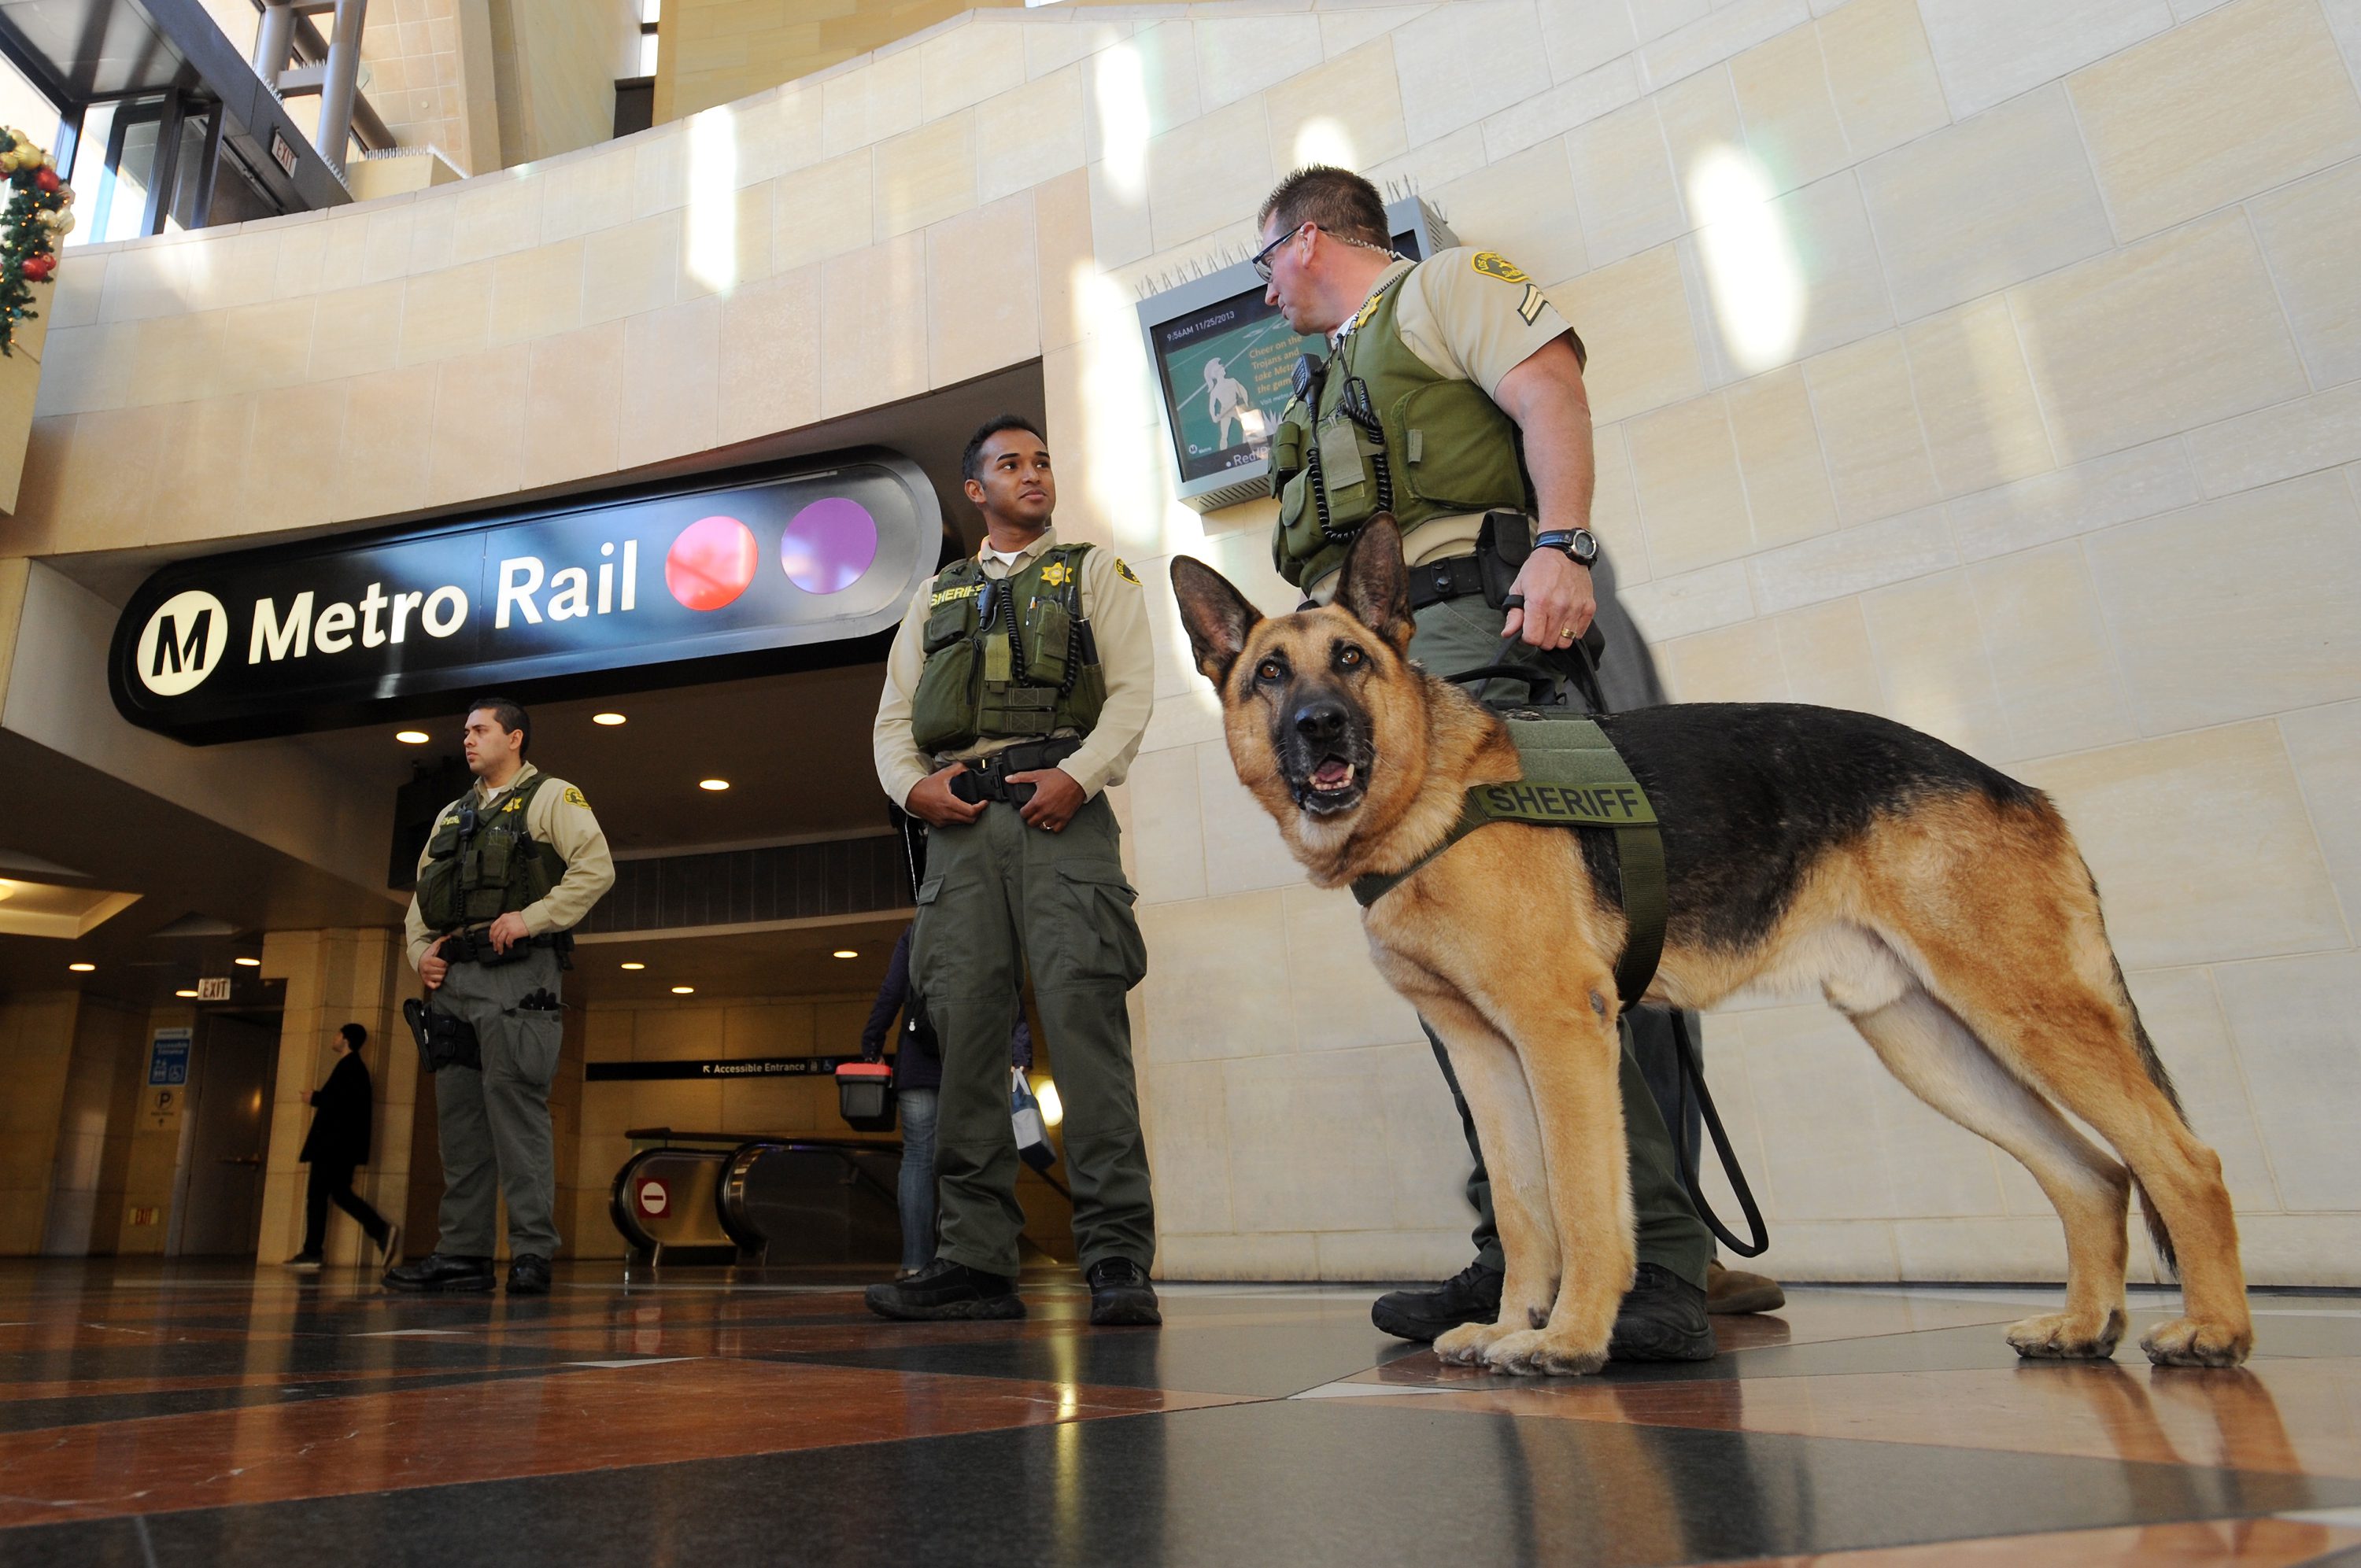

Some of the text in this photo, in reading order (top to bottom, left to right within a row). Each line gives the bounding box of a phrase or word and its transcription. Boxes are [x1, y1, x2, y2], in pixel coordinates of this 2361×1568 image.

[276, 138, 296, 171] EXIT
[1166, 310, 1235, 342] 9:56AM 11/25/2013
[1249, 335, 1303, 359] Cheer on the
[1251, 346, 1299, 370] Trojans and
[1255, 371, 1272, 382] take
[1257, 378, 1292, 393] the gam
[248, 582, 469, 665] Metro
[494, 538, 639, 630] Rail
[1486, 786, 1639, 818] SHERIFF
[203, 980, 227, 998] EXIT
[713, 1062, 806, 1074] Accessible Entrance
